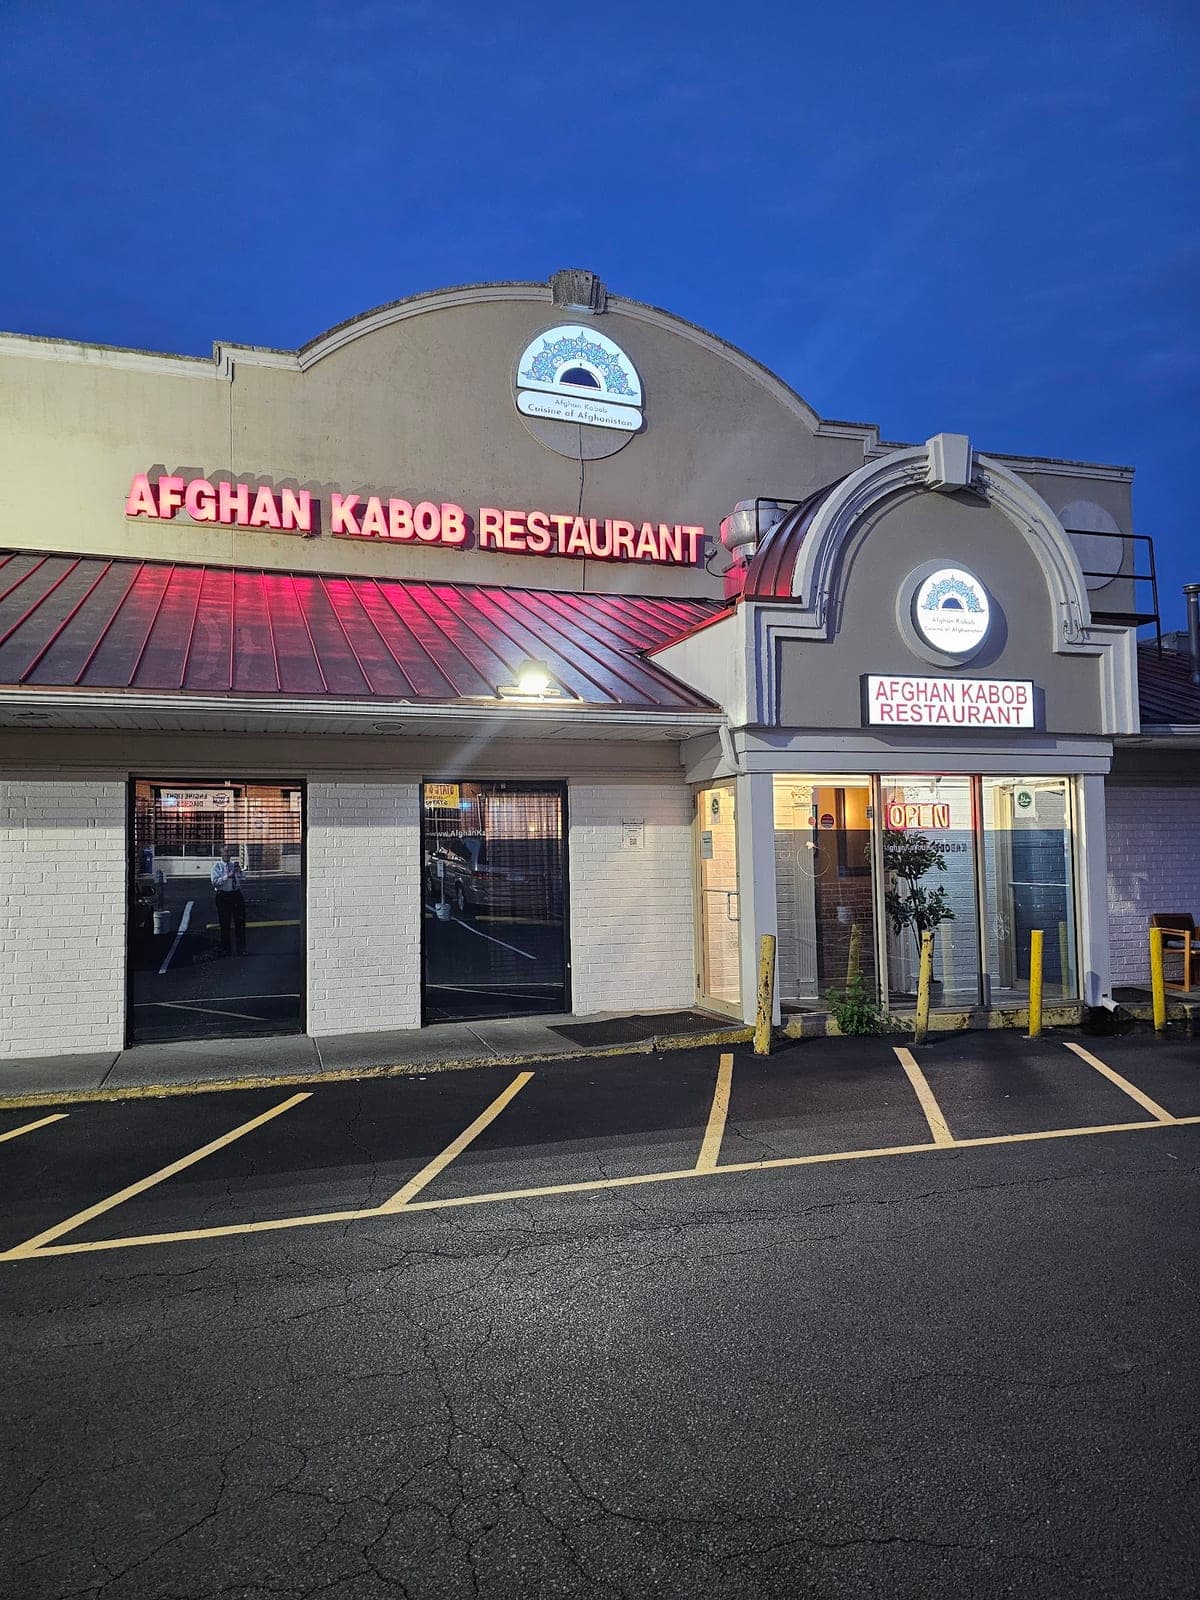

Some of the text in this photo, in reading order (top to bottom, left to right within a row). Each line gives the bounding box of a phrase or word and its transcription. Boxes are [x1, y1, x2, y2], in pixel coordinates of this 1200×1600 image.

[527, 403, 633, 427] Cuisine of Afghanistan
[554, 399, 608, 414] Afghan Kabob
[125, 472, 706, 564] AFGHAN KABOB RESTAURANT
[875, 681, 1028, 705] AFGHAN KABOB
[880, 703, 1024, 725] RESTAURANT
[890, 805, 949, 828] OPEN
